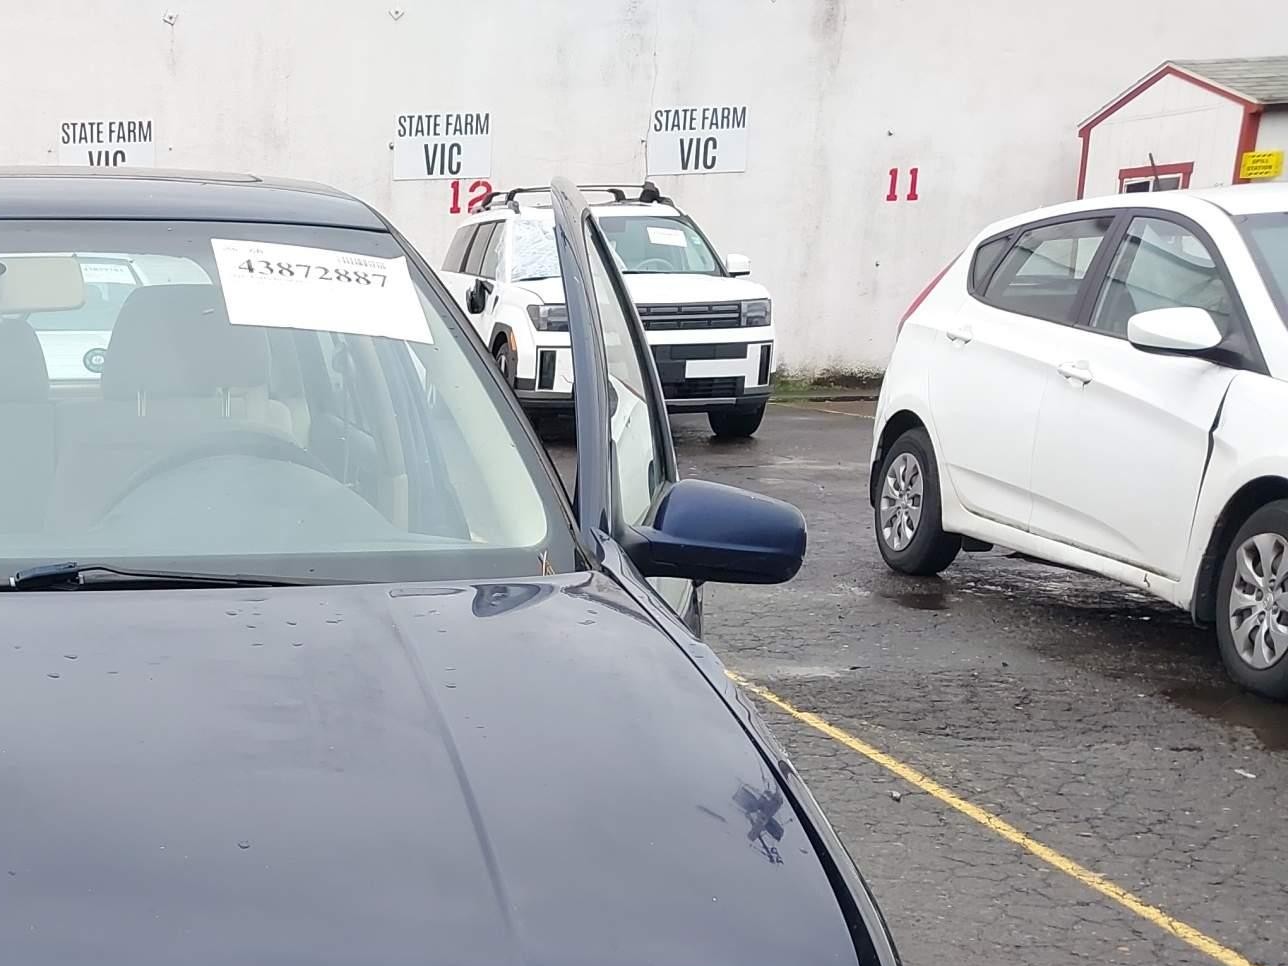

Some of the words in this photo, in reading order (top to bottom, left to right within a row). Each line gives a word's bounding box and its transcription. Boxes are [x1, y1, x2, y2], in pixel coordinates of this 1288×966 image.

[61, 121, 104, 145] STATE
[108, 120, 152, 143] FARM
[398, 114, 441, 138] STATE
[445, 113, 490, 136] FARM
[652, 109, 698, 132] STATE
[701, 106, 747, 130] FARM
[423, 143, 462, 176] VIC
[679, 137, 718, 171] VIC
[449, 180, 492, 214] 12
[885, 167, 919, 202] 11
[237, 258, 388, 288] 43872887
